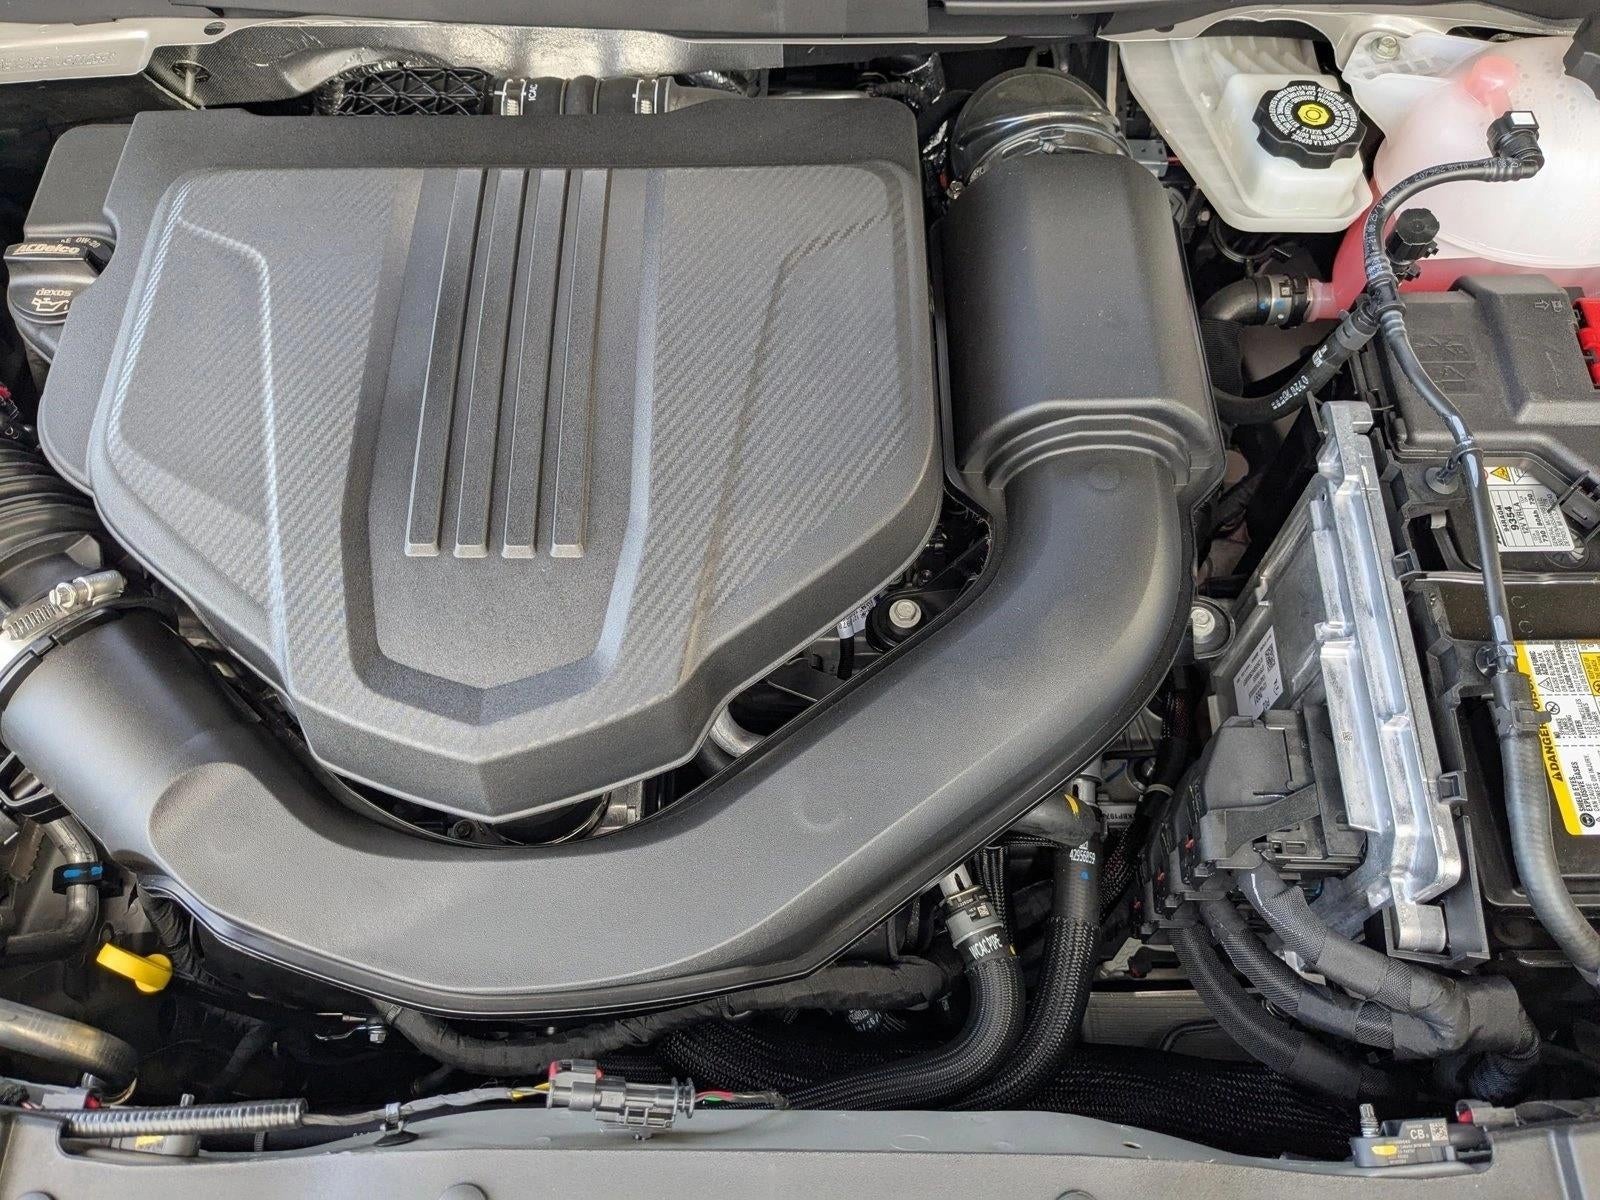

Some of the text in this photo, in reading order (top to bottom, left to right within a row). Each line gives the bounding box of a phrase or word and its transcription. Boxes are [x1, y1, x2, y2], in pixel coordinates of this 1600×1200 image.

[76, 237, 100, 248] 0W-20
[14, 243, 81, 255] ACDelco
[36, 288, 73, 296] dexos
[1527, 493, 1535, 505] 730
[1514, 502, 1524, 521] VRLA
[1504, 506, 1519, 530] 9354
[1521, 523, 1530, 534] 12V
[1541, 530, 1549, 542] 730
[1529, 650, 1540, 675] SULFURIC
[1539, 663, 1548, 675] ACID
[1539, 722, 1559, 770] DANGER
[1570, 761, 1593, 811] EXPLOSIVE GASES
[1573, 792, 1586, 812] SHIELD
[1589, 801, 1599, 811] CAN
[1410, 1129, 1425, 1140] CB
